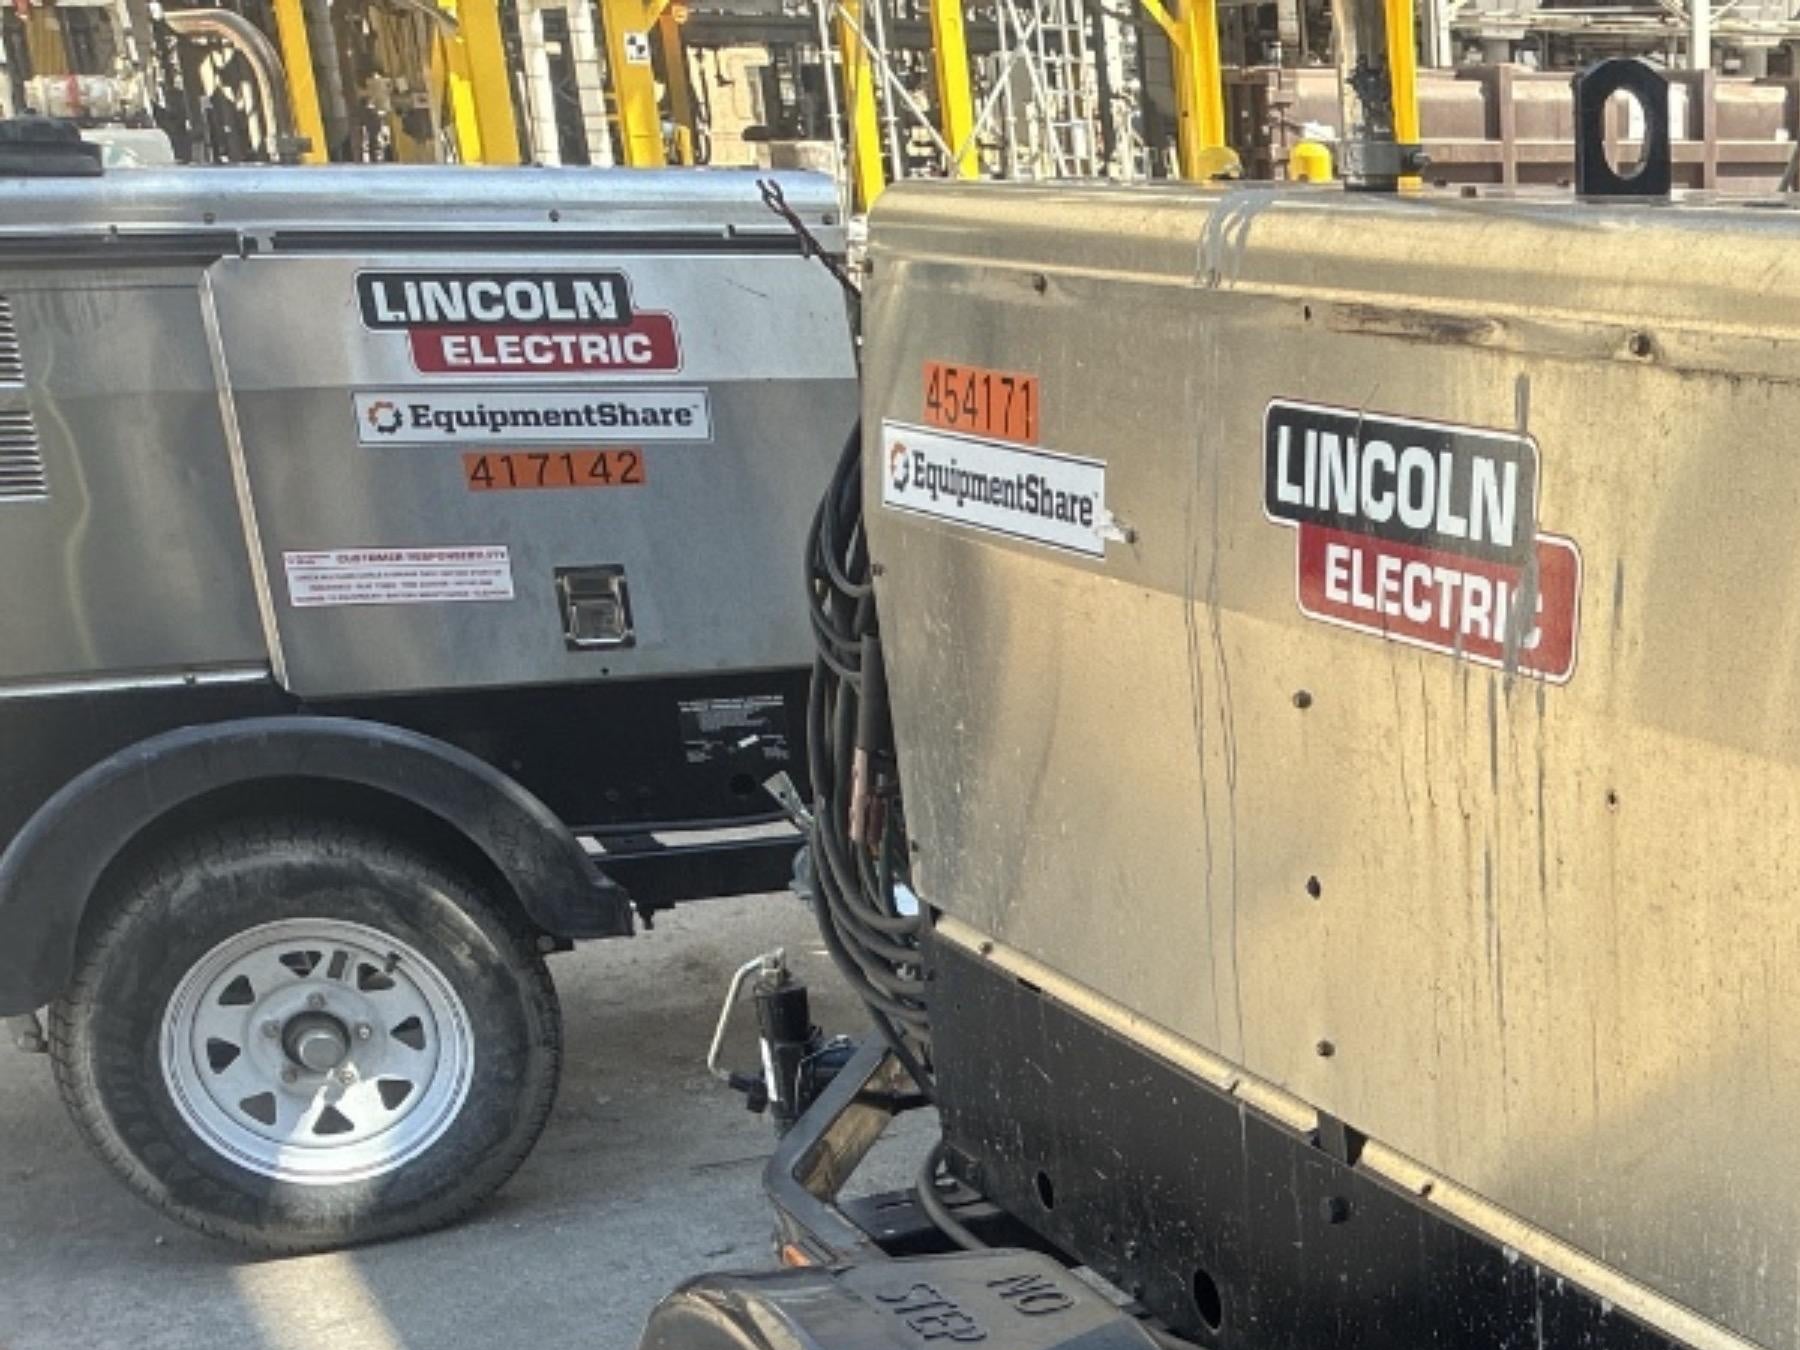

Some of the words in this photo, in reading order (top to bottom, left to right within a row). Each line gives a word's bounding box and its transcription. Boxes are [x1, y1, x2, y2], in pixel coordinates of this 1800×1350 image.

[370, 280, 619, 322] LINCOLN
[440, 333, 653, 366] ELECTRIC
[407, 402, 693, 433] EquipmentShare
[926, 366, 1031, 439] 454171
[470, 450, 641, 488] 417142
[912, 449, 1094, 528] EquipmentShare
[1276, 425, 1517, 547] LINCOLN
